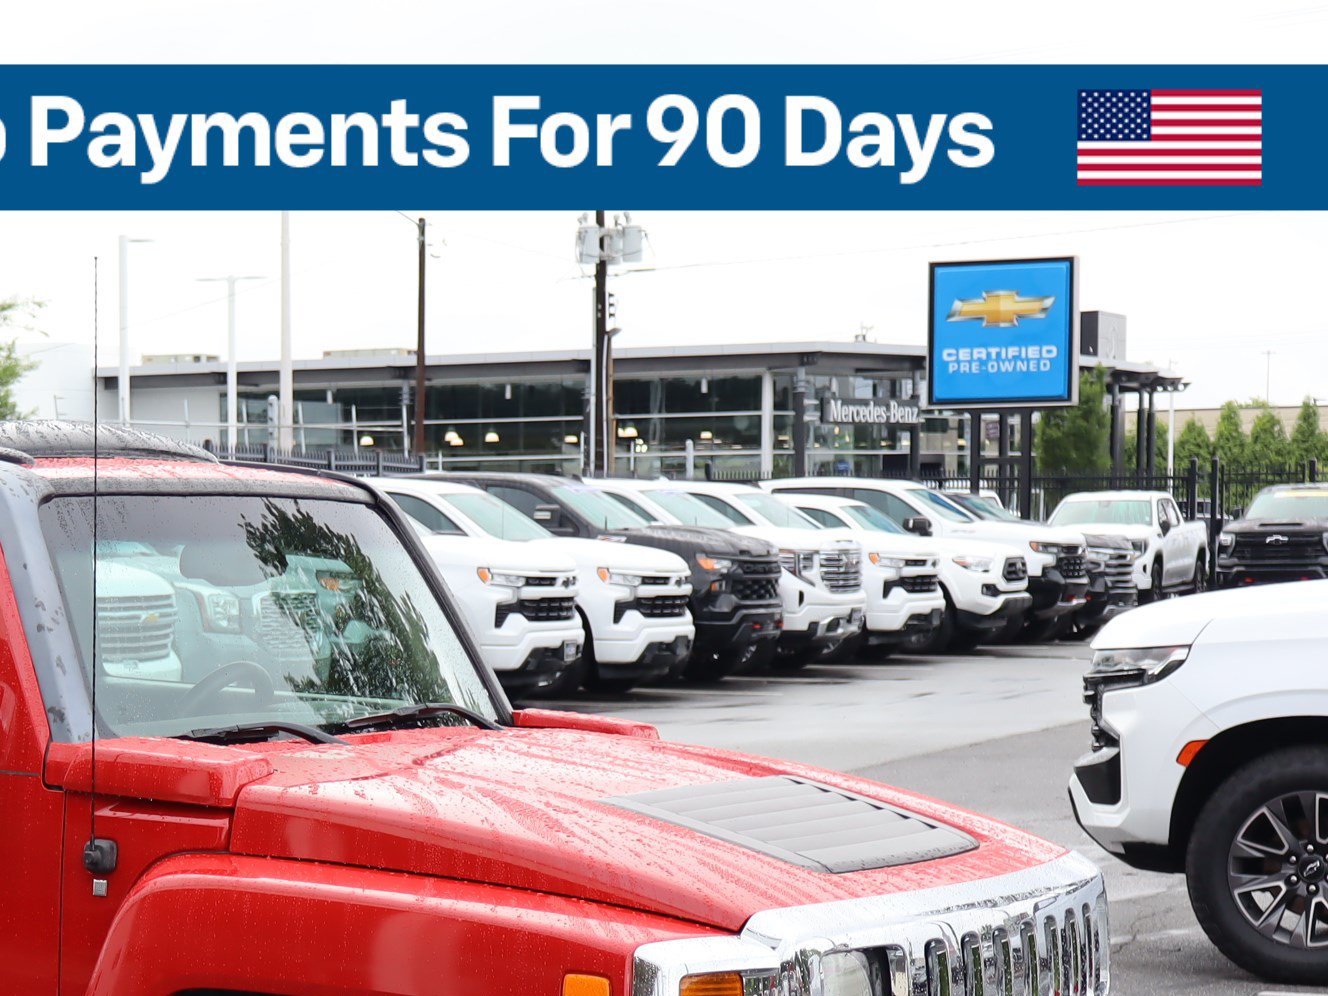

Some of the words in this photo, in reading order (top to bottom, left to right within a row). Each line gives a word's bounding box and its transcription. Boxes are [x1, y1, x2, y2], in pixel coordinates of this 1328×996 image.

[942, 345, 1058, 361] CERTIFIED
[948, 360, 1051, 374] PRE-OWNED
[830, 399, 919, 424] Mercedes-Benz
